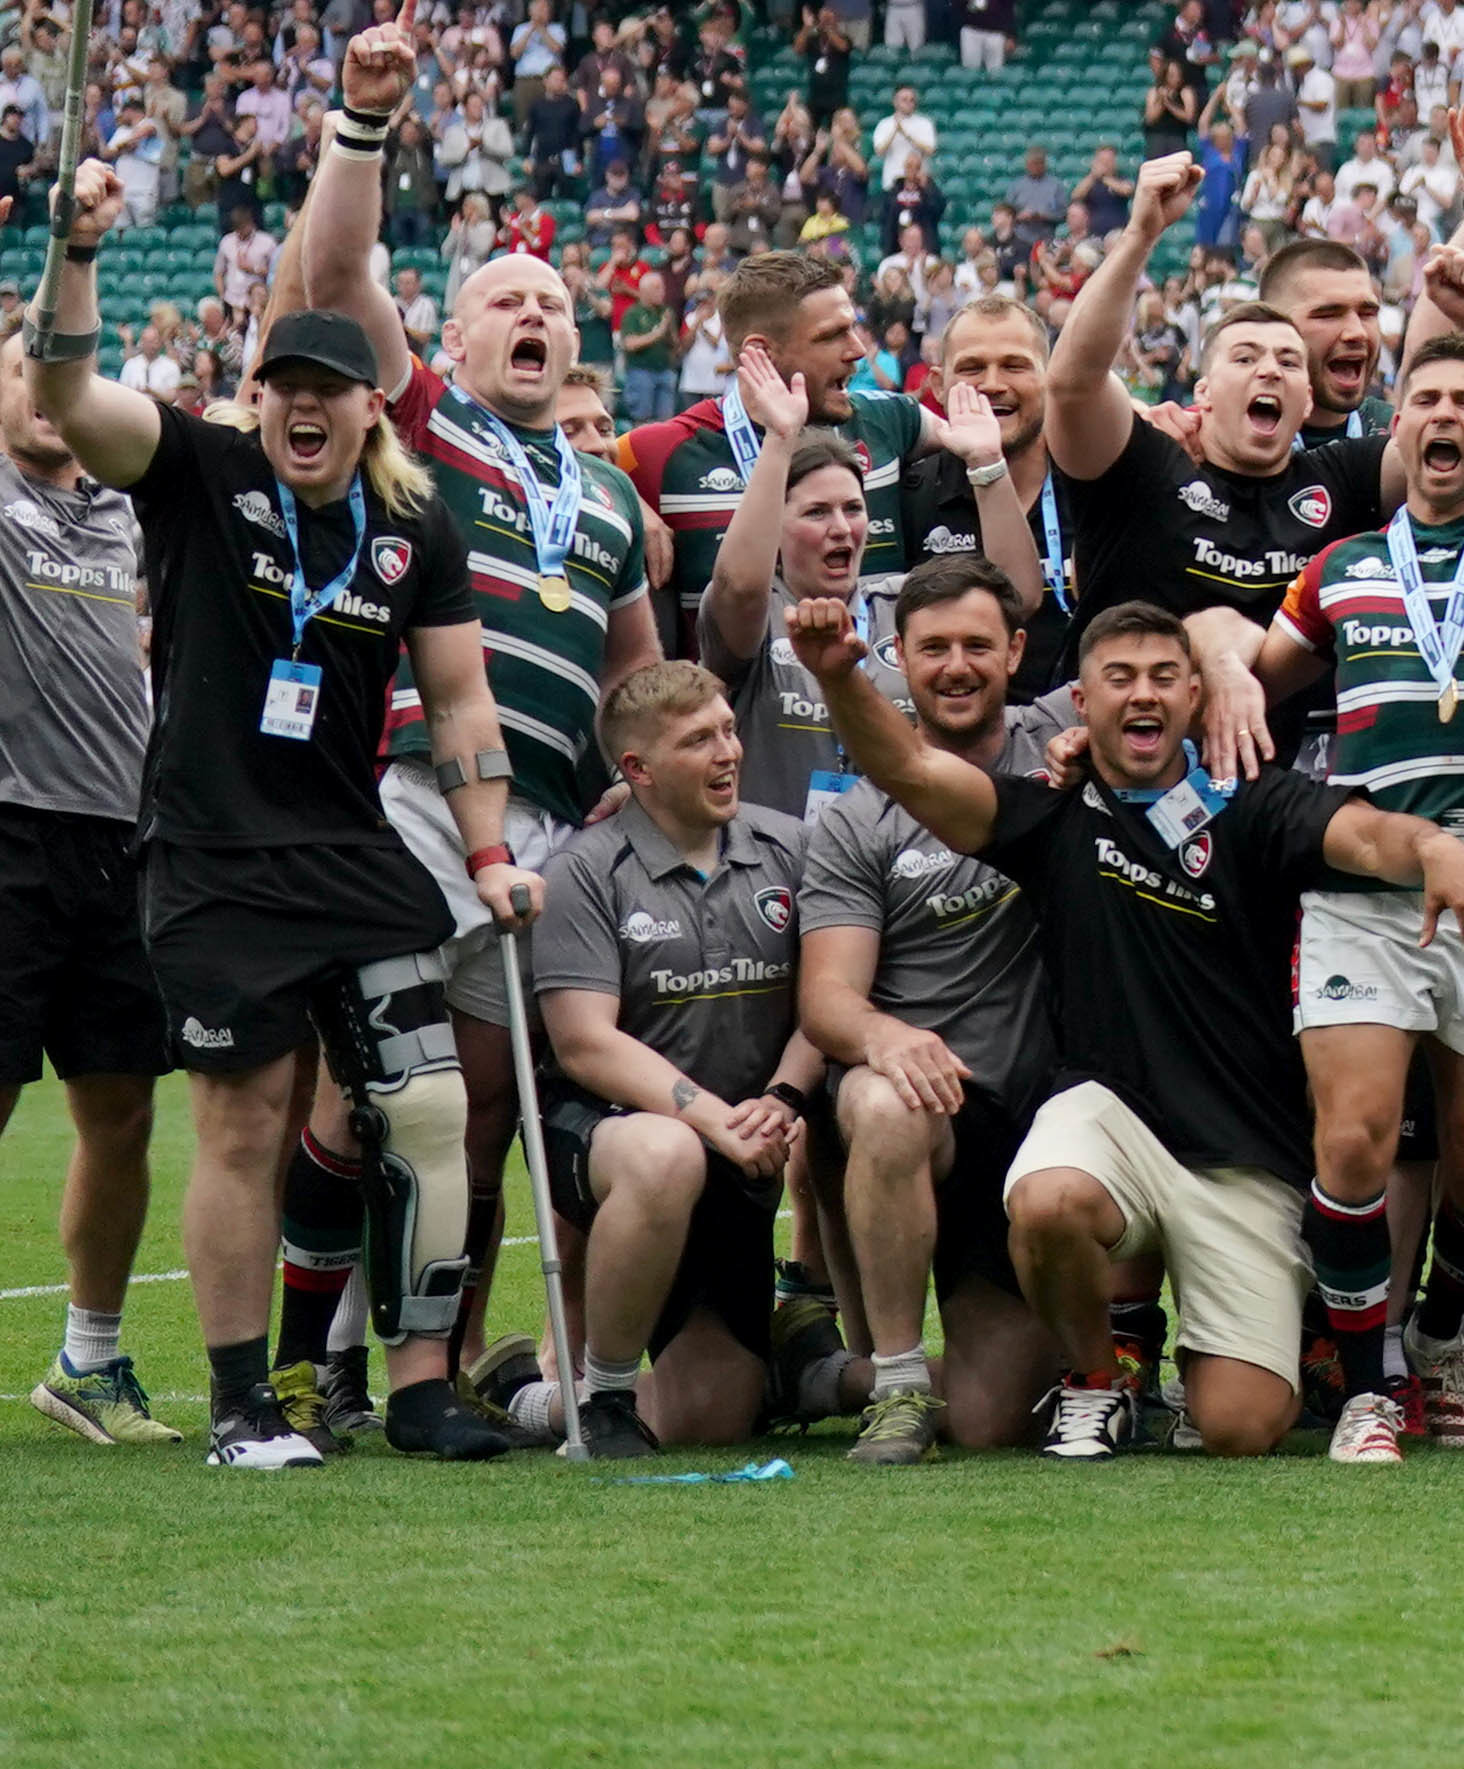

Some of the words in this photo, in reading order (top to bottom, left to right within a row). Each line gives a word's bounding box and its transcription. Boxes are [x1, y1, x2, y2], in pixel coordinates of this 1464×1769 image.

[478, 487, 533, 535] Top
[572, 530, 620, 575] Tiles
[27, 550, 105, 588] Topps
[107, 565, 138, 592] Tile
[1194, 537, 1264, 577] Topps
[1343, 617, 1415, 648] Topp
[778, 692, 829, 722] Top
[1095, 837, 1161, 889] Tops
[651, 963, 732, 996] Topps
[731, 954, 791, 985] Tiles
[309, 1252, 360, 1268] TIGER
[1323, 1292, 1367, 1307] GERS
